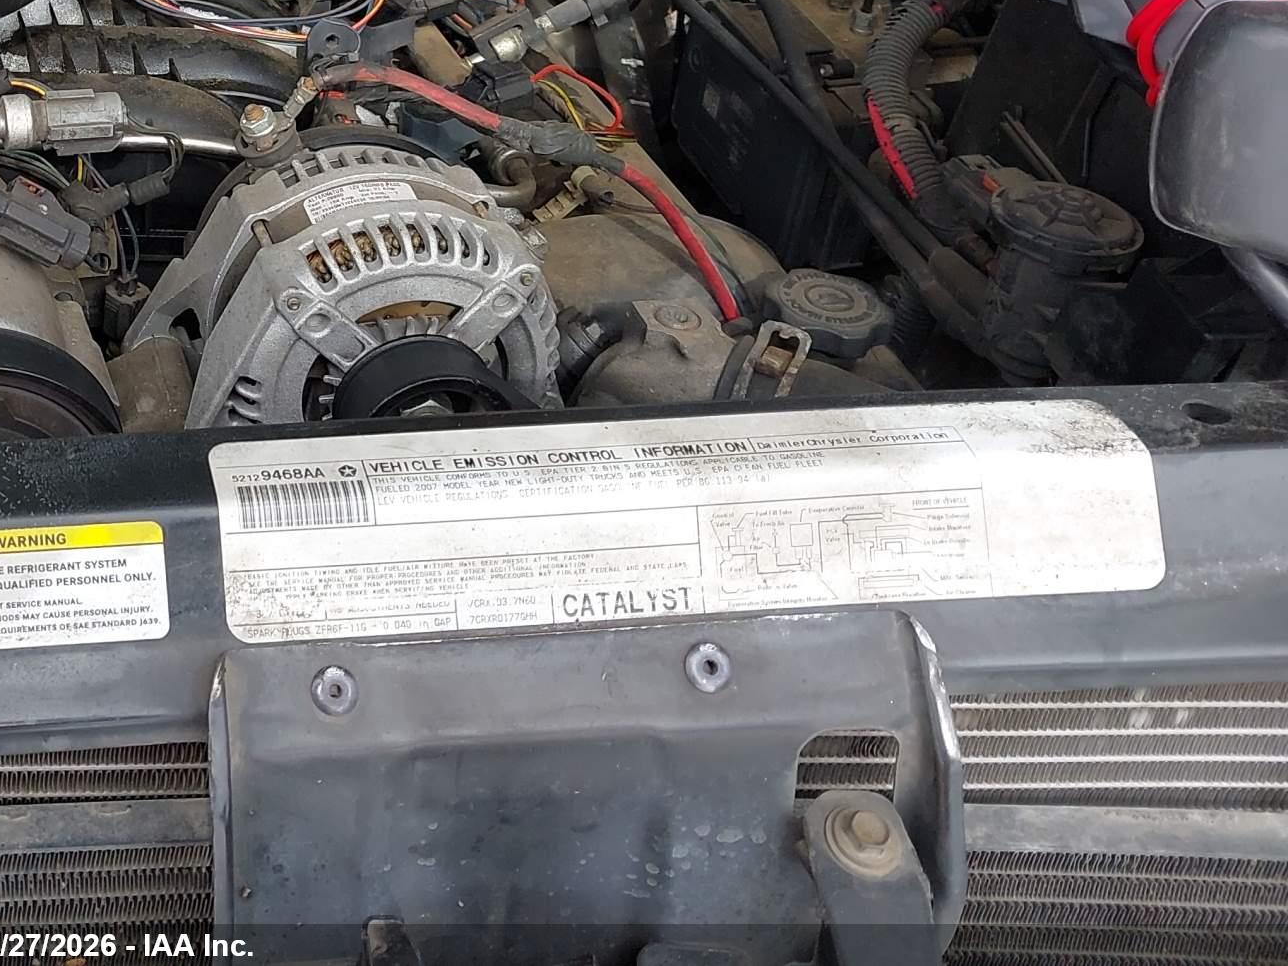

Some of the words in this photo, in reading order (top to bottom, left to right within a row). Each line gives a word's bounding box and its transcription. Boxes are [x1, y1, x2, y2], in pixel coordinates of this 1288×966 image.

[756, 436, 861, 451] DaimlerChrysler
[868, 431, 949, 444] Corporation
[369, 458, 444, 473] VEHICLE
[453, 453, 539, 469] EMISSION
[547, 448, 623, 463] CONTROL
[633, 441, 747, 458] INFORMATION
[231, 467, 324, 483] 52129468AA
[401, 474, 440, 483] VEHICLE
[445, 471, 490, 480] CONFORMS
[634, 459, 696, 469] REGULATIONS
[702, 456, 757, 465] APPLICABLE
[779, 452, 824, 461] GASOLINE
[375, 484, 410, 493] FUELED
[415, 482, 436, 491] 2007
[443, 480, 471, 489] MODEL
[478, 479, 499, 487] YEAR
[504, 477, 522, 486] NEW
[589, 471, 623, 481] TRUCKS
[629, 470, 646, 479] AND
[650, 468, 679, 477] MEETS
[712, 465, 728, 474] EPA
[768, 462, 791, 471] FUEL
[795, 460, 824, 469] FLEET
[7, 561, 81, 574] REFRIGERANT
[84, 558, 126, 570] SYSTEM
[56, 574, 121, 586] PERSONNEL
[123, 572, 156, 582] ONLY.
[5, 600, 41, 609] SERVICE
[561, 586, 693, 618] CATALYST
[22, 612, 40, 620] MAY
[42, 610, 70, 619] CAUSE
[73, 607, 118, 617] PERSONAL
[120, 605, 153, 614] INJURY.
[59, 623, 70, 631] OF
[73, 621, 89, 630] SAE
[91, 618, 137, 629] STANDARD
[433, 616, 452, 628] GAP
